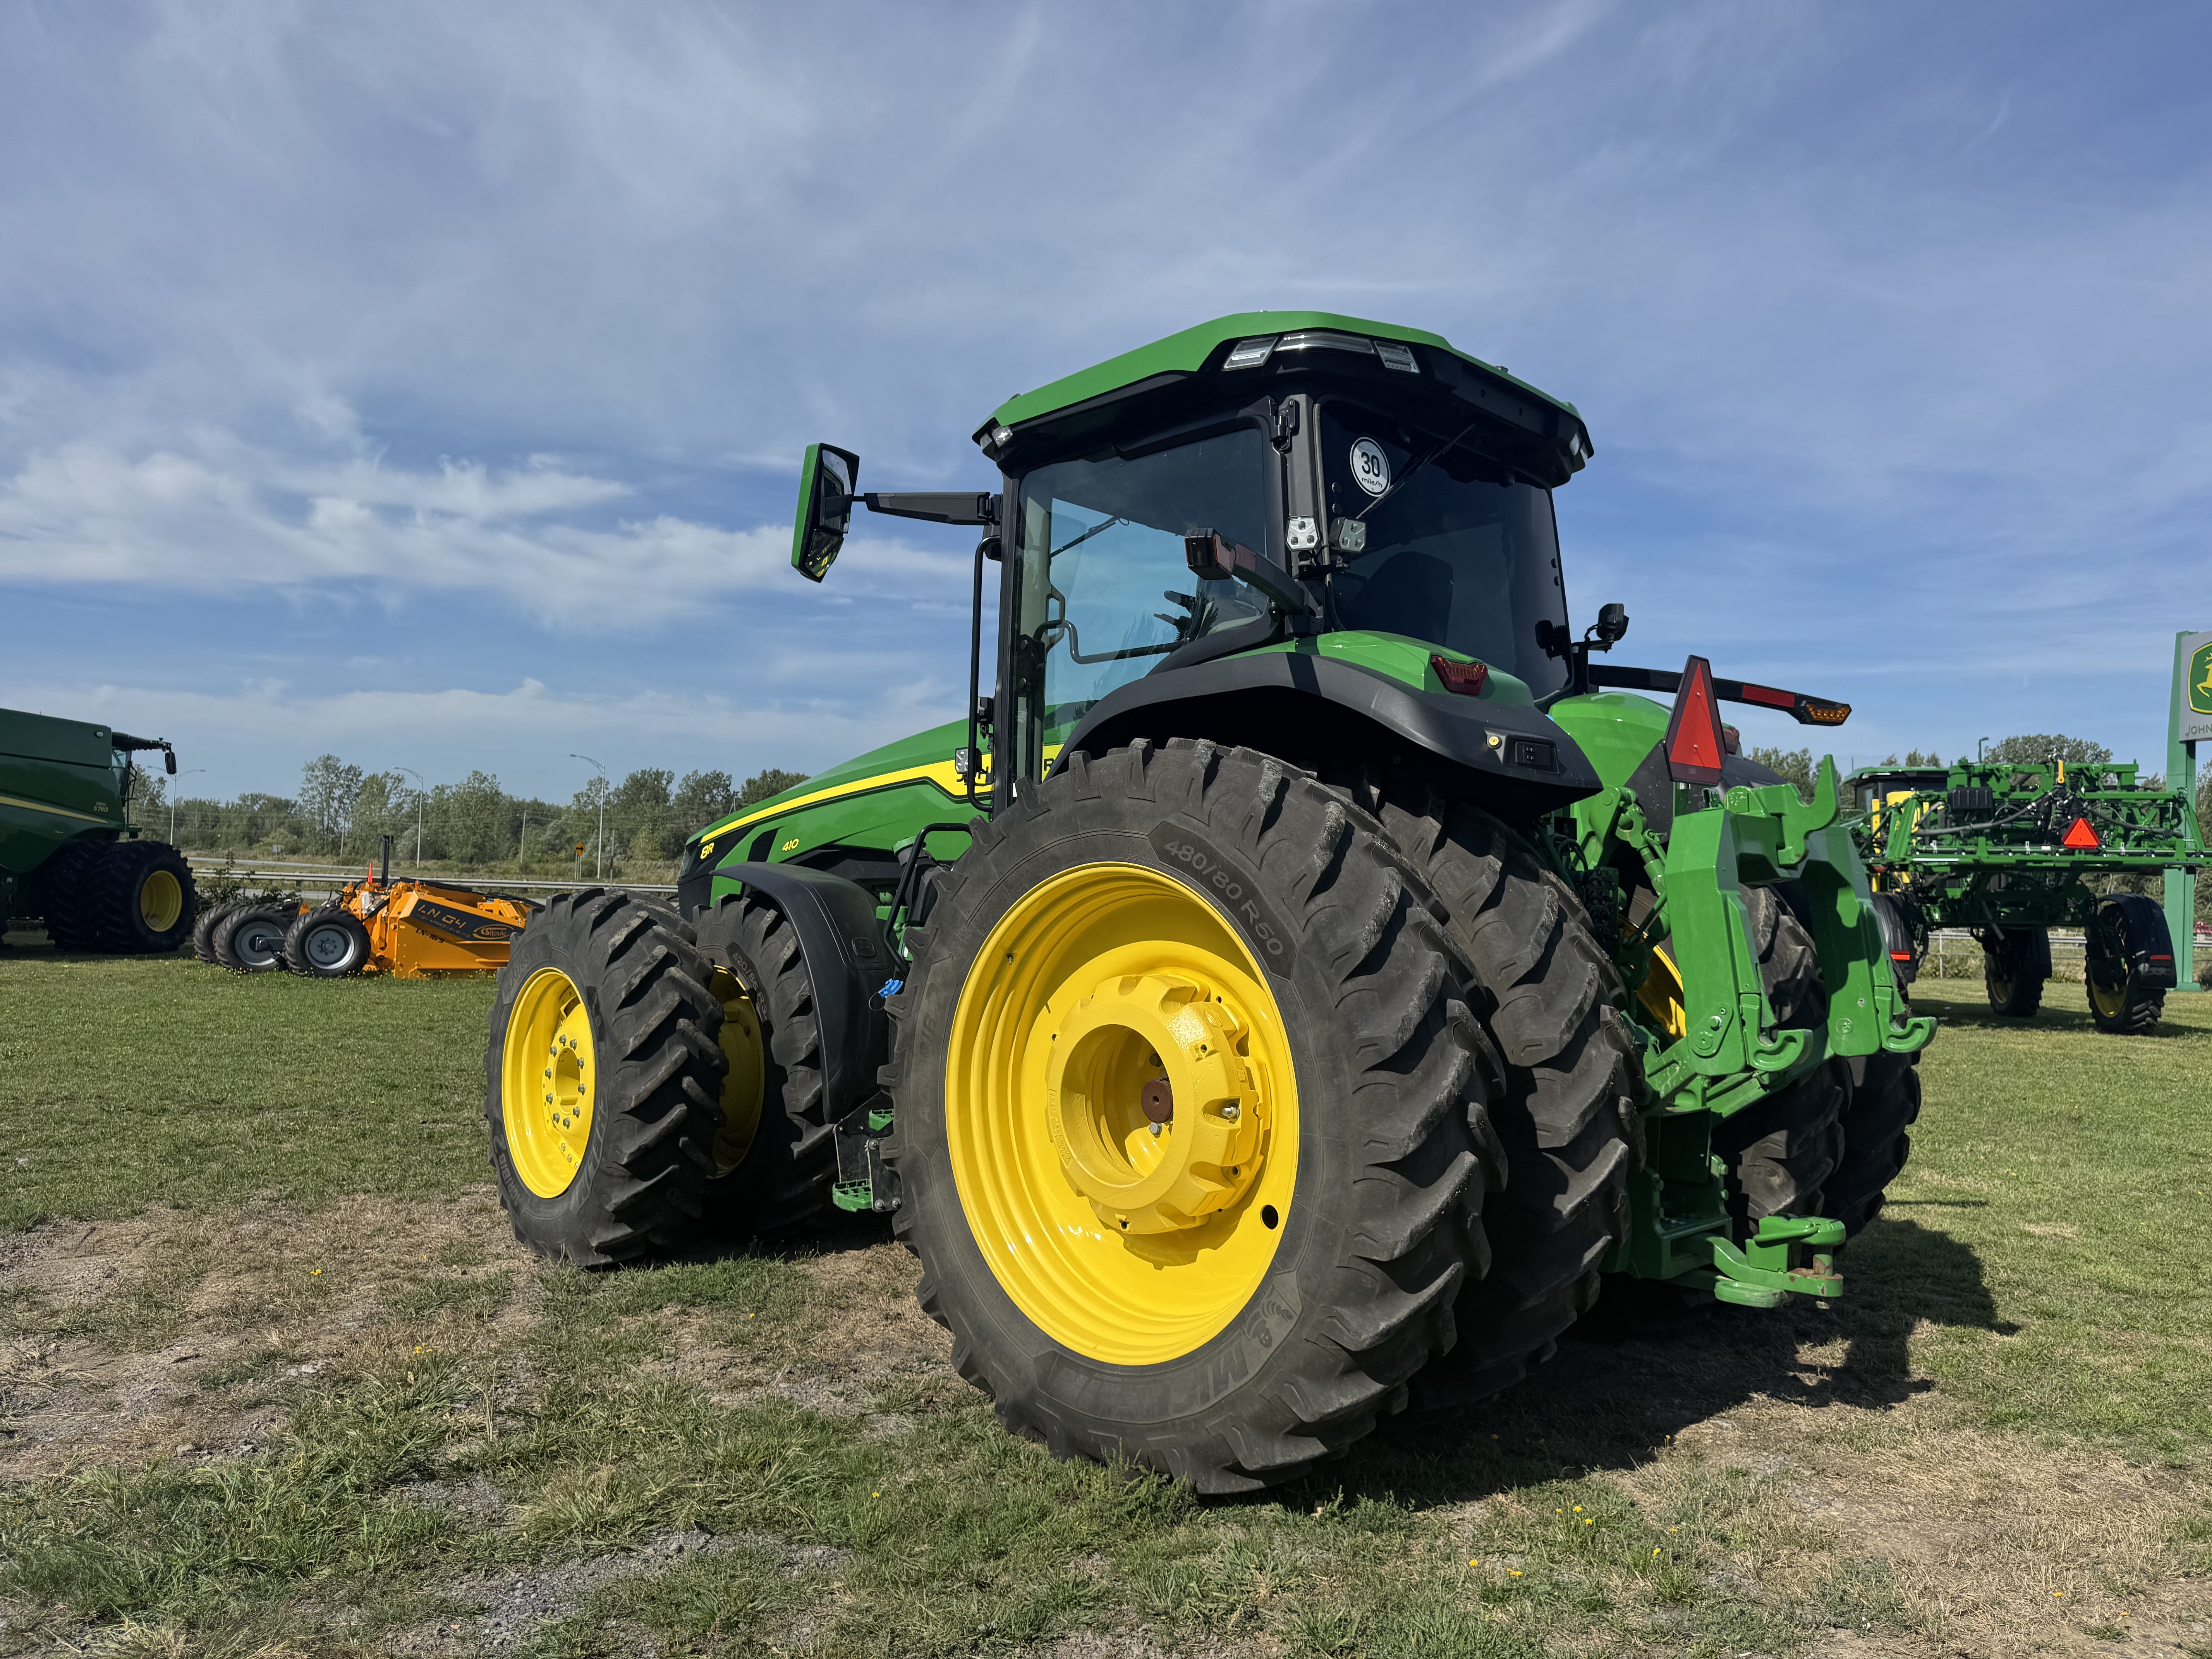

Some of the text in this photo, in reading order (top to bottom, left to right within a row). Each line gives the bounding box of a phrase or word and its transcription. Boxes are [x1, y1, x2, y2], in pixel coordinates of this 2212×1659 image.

[1361, 452, 1380, 477] 30
[1362, 478, 1382, 488] mile/h
[2185, 724, 2212, 737] JOHN
[700, 842, 714, 859] 8R
[782, 838, 799, 852] 410
[1164, 841, 1283, 955] 480/80 R50
[418, 904, 441, 918] LN
[441, 915, 467, 929] G4
[732, 952, 759, 991] 420/85
